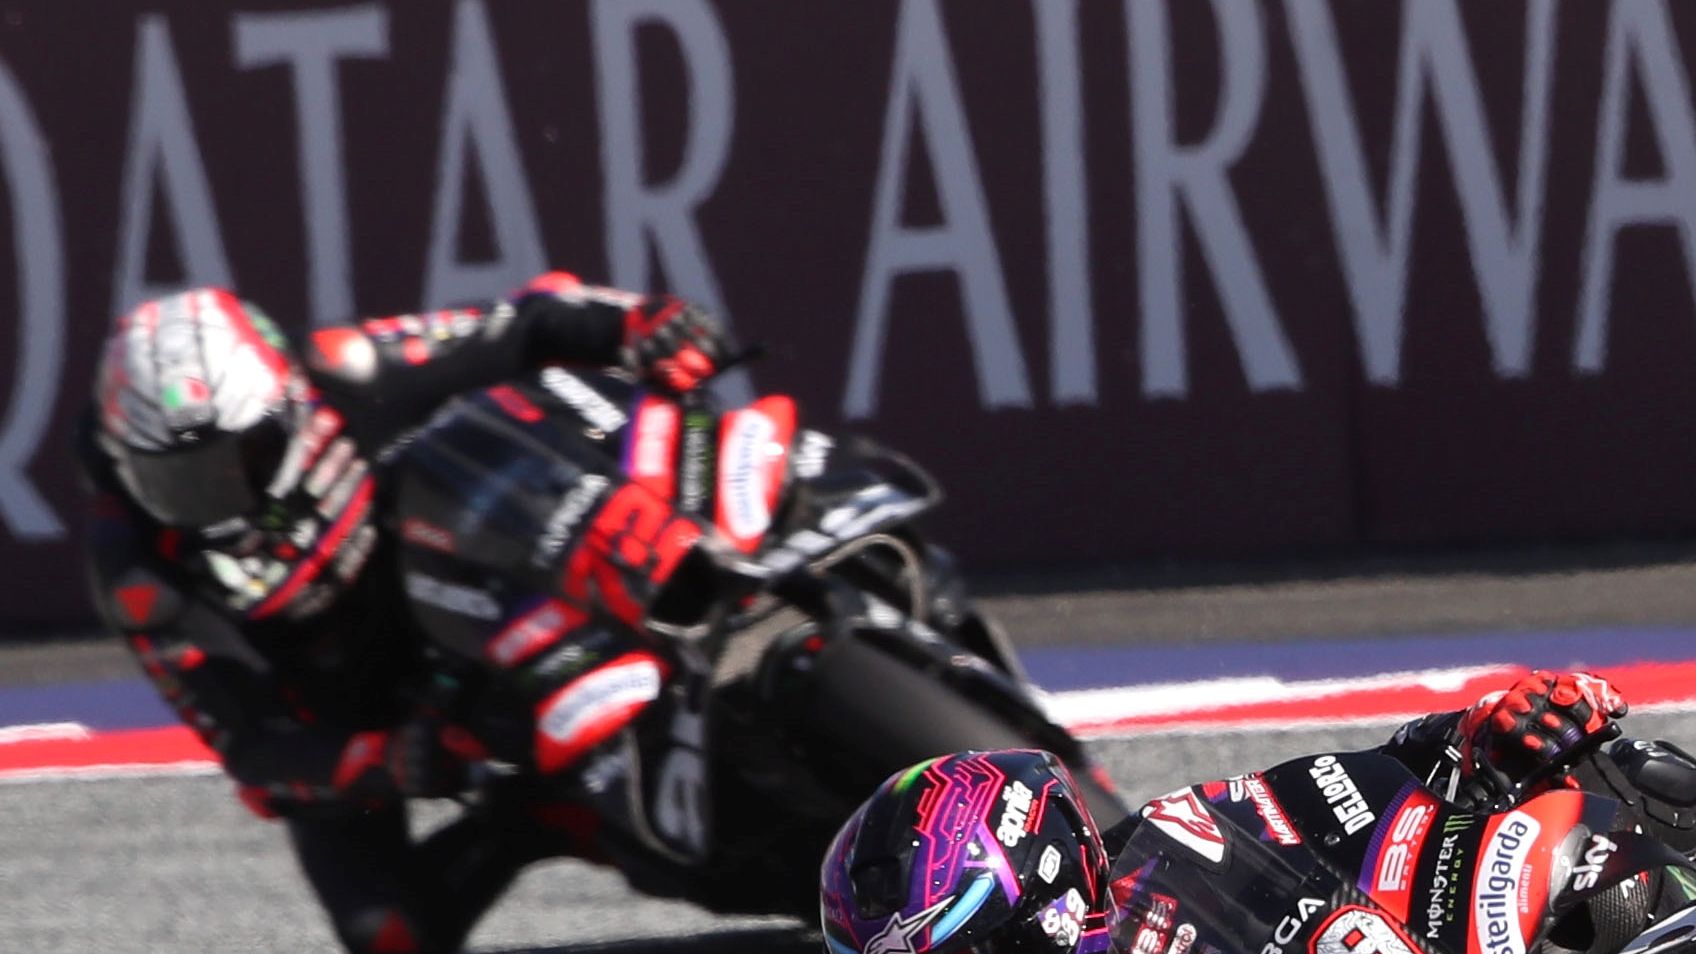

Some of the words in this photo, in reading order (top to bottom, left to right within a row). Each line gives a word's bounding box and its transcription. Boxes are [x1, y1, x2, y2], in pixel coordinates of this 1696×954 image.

[996, 780, 1034, 847] aprilia
[1377, 805, 1427, 892] BS
[1427, 834, 1459, 939] MONSTER
[1573, 834, 1618, 891] sky
